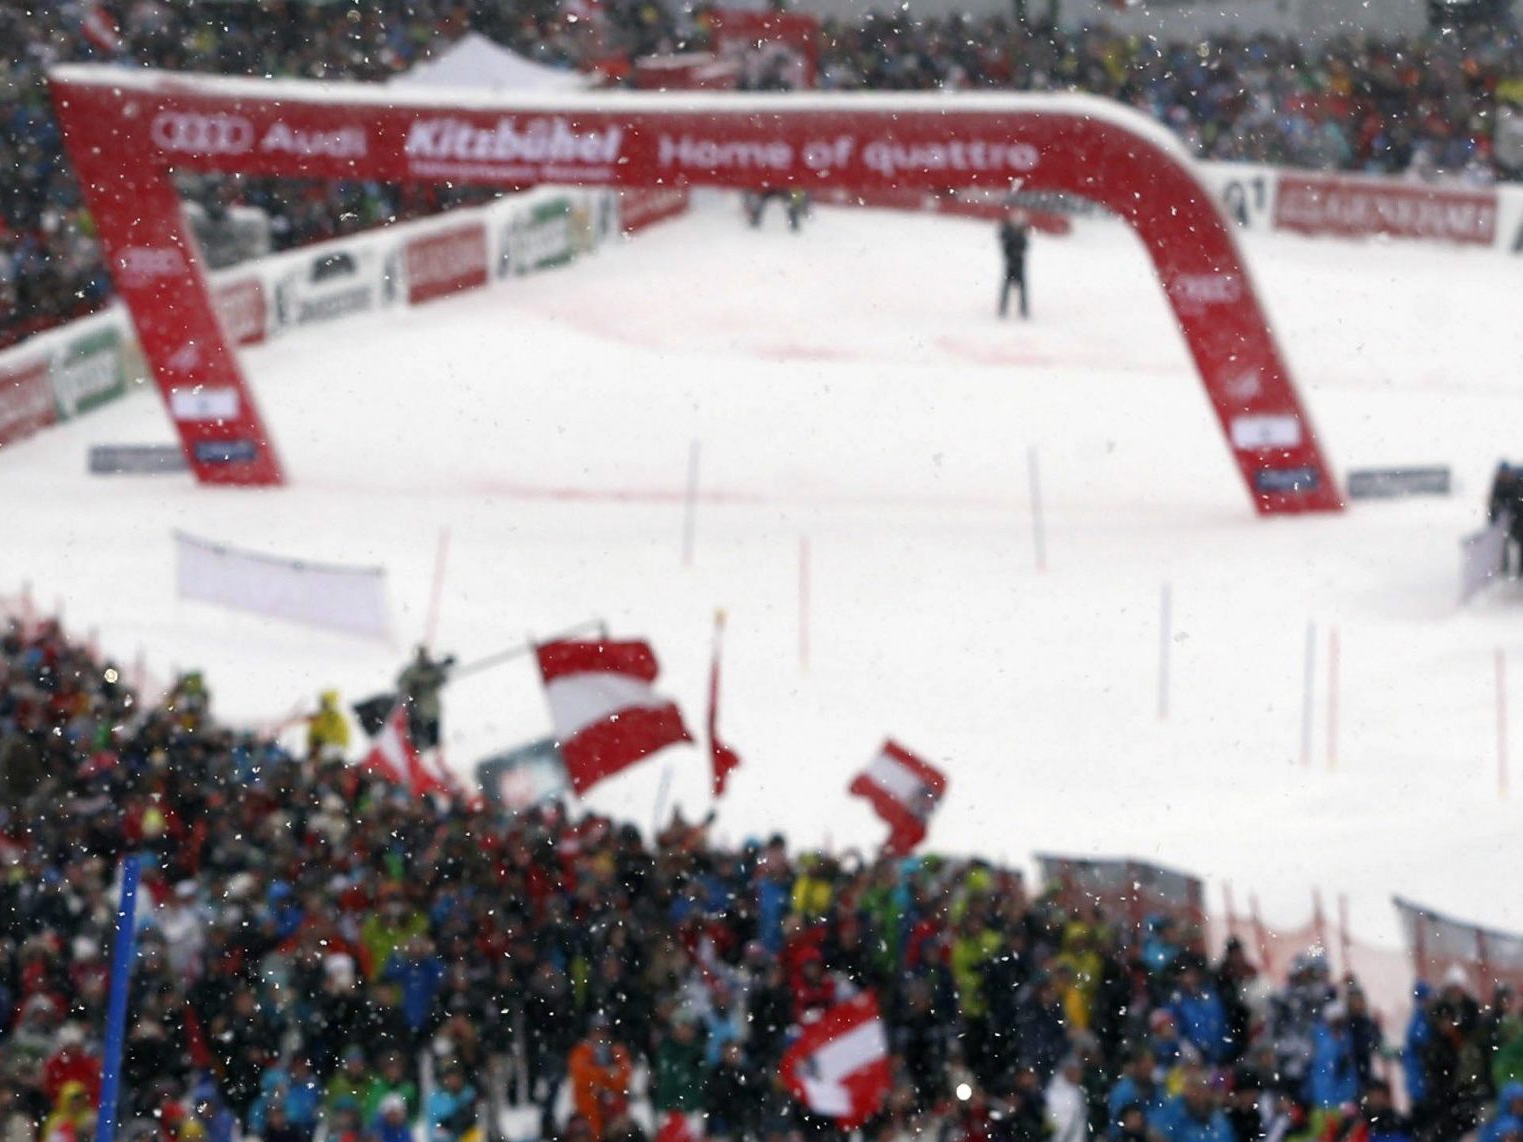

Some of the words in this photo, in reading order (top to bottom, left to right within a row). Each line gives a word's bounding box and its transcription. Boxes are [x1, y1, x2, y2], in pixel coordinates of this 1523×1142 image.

[261, 122, 367, 156] Audi
[405, 115, 623, 163] Kitzbühel
[657, 135, 793, 171] Home
[802, 136, 854, 171] of
[863, 139, 1039, 178] quattro
